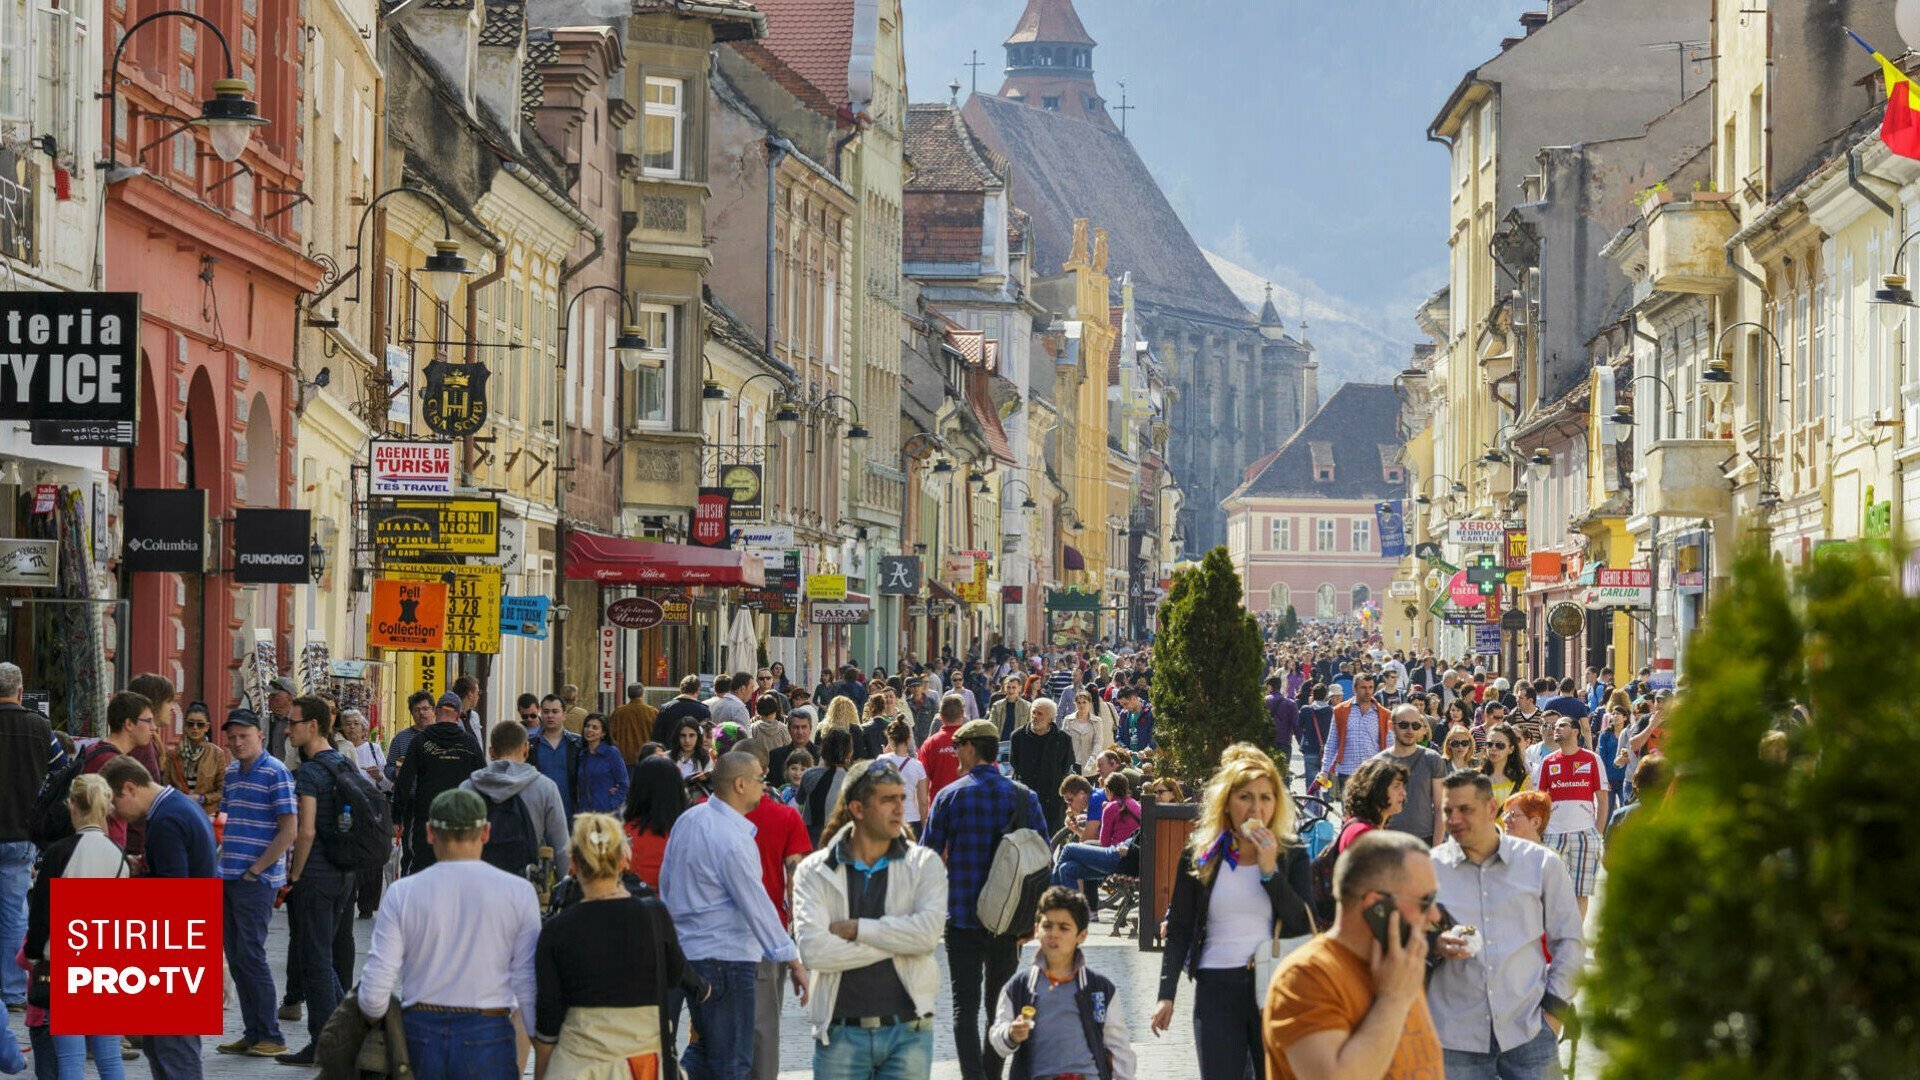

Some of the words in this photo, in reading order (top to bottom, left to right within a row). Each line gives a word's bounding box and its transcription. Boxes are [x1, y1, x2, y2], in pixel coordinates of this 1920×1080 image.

[7, 309, 121, 345] teria
[49, 353, 121, 404] ICE
[376, 446, 430, 459] AGENTIE
[434, 447, 450, 459] DE
[375, 459, 450, 474] TURISM
[376, 483, 399, 491] TES
[404, 483, 450, 492] TRAVEL
[697, 503, 723, 519] MUSIK
[698, 521, 720, 537] CAFE
[1460, 521, 1501, 531] XEROX
[142, 538, 198, 551] Columbia
[241, 553, 304, 565] FUNDANGO
[388, 563, 447, 573] EXCHANGE
[1601, 569, 1621, 586] AGENTIE
[1623, 569, 1631, 586] DE
[1632, 569, 1650, 586] TURISM
[400, 586, 420, 598] Pell
[1600, 588, 1640, 597] CARLIDA
[449, 599, 479, 615] 3.28
[662, 603, 688, 611] BEER
[814, 609, 864, 618] SARAY
[506, 609, 515, 620] DE
[516, 609, 542, 622] TURISM
[378, 621, 436, 637] Collection
[447, 617, 475, 633] 5.42
[448, 634, 477, 651] 3.75
[603, 629, 614, 690] OUTLET
[1557, 779, 1590, 788] Santander
